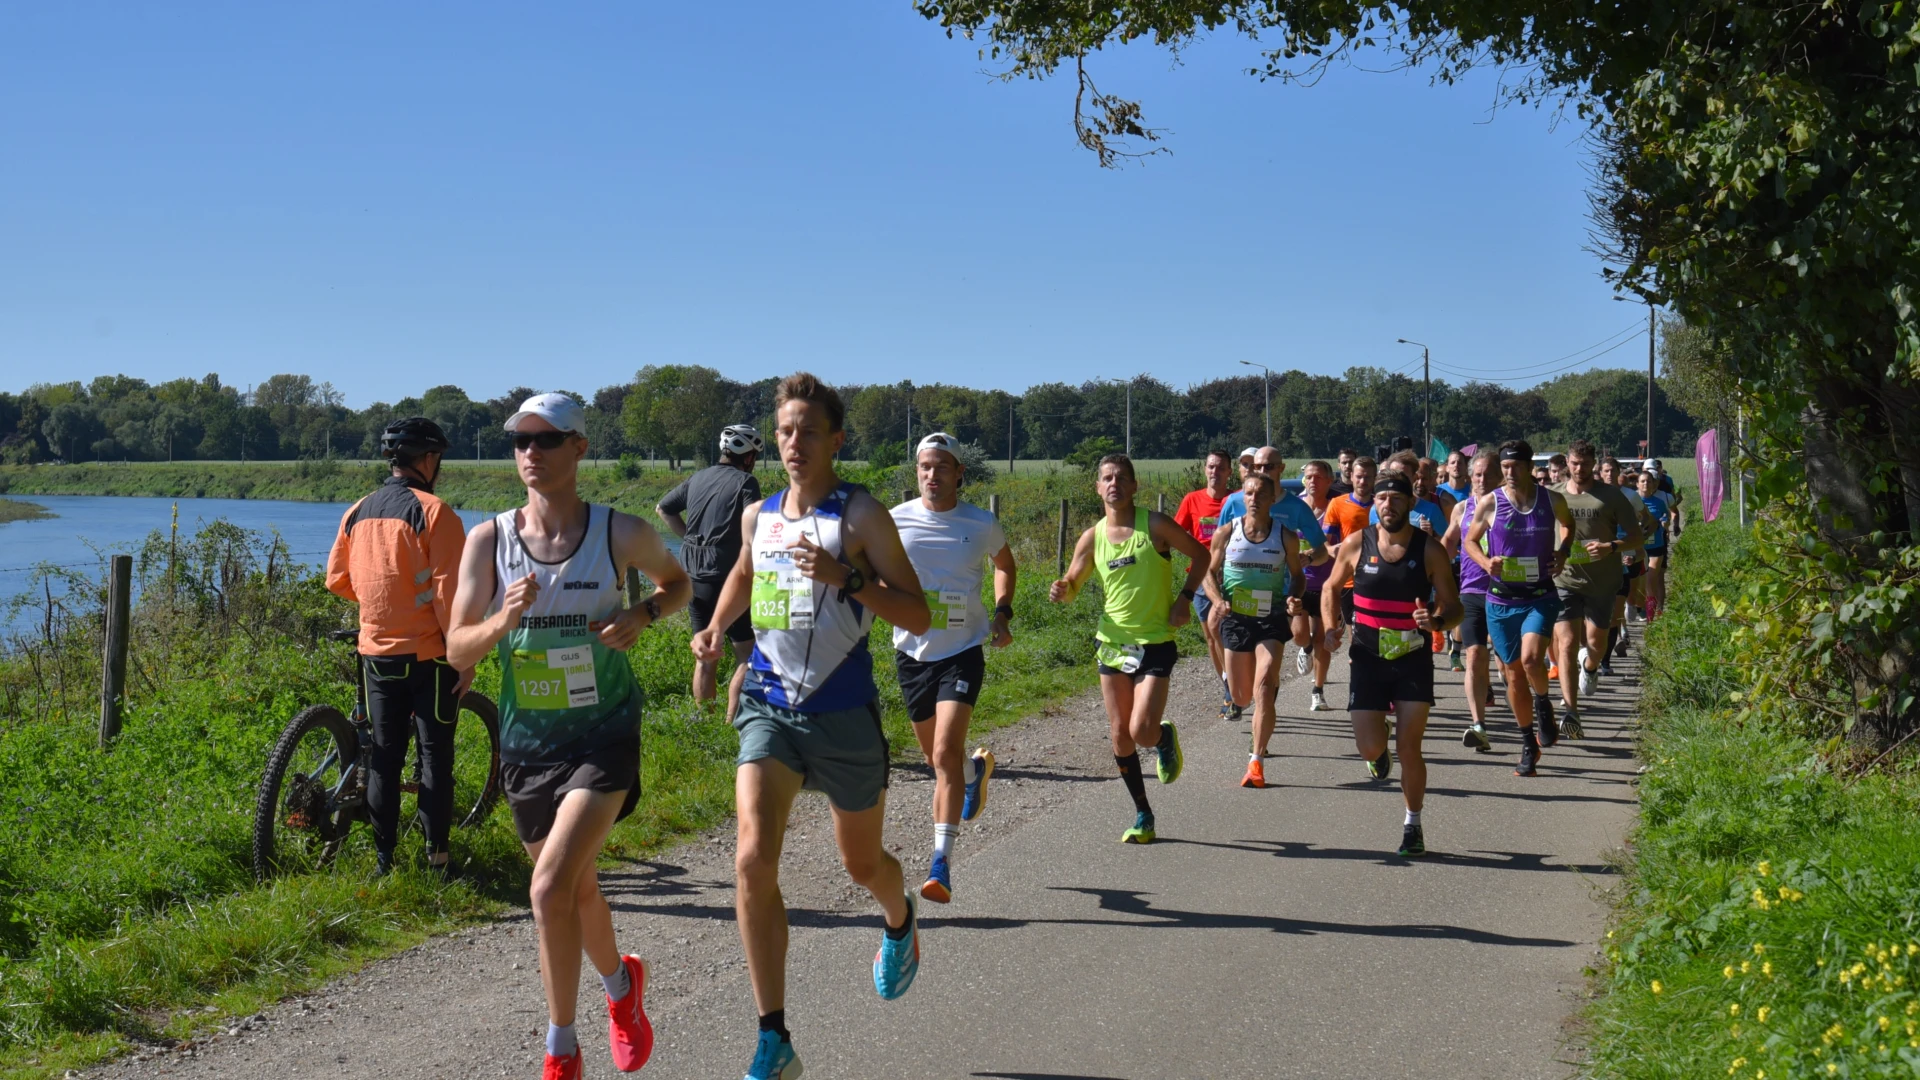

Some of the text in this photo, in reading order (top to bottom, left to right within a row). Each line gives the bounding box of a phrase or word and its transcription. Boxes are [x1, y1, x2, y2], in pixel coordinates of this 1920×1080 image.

[754, 600, 786, 617] 1325
[1235, 599, 1256, 611] 1367
[560, 629, 587, 639] BRICKS
[561, 652, 580, 662] GIJS
[566, 663, 593, 676] 10MLS
[520, 679, 562, 697] 1297
